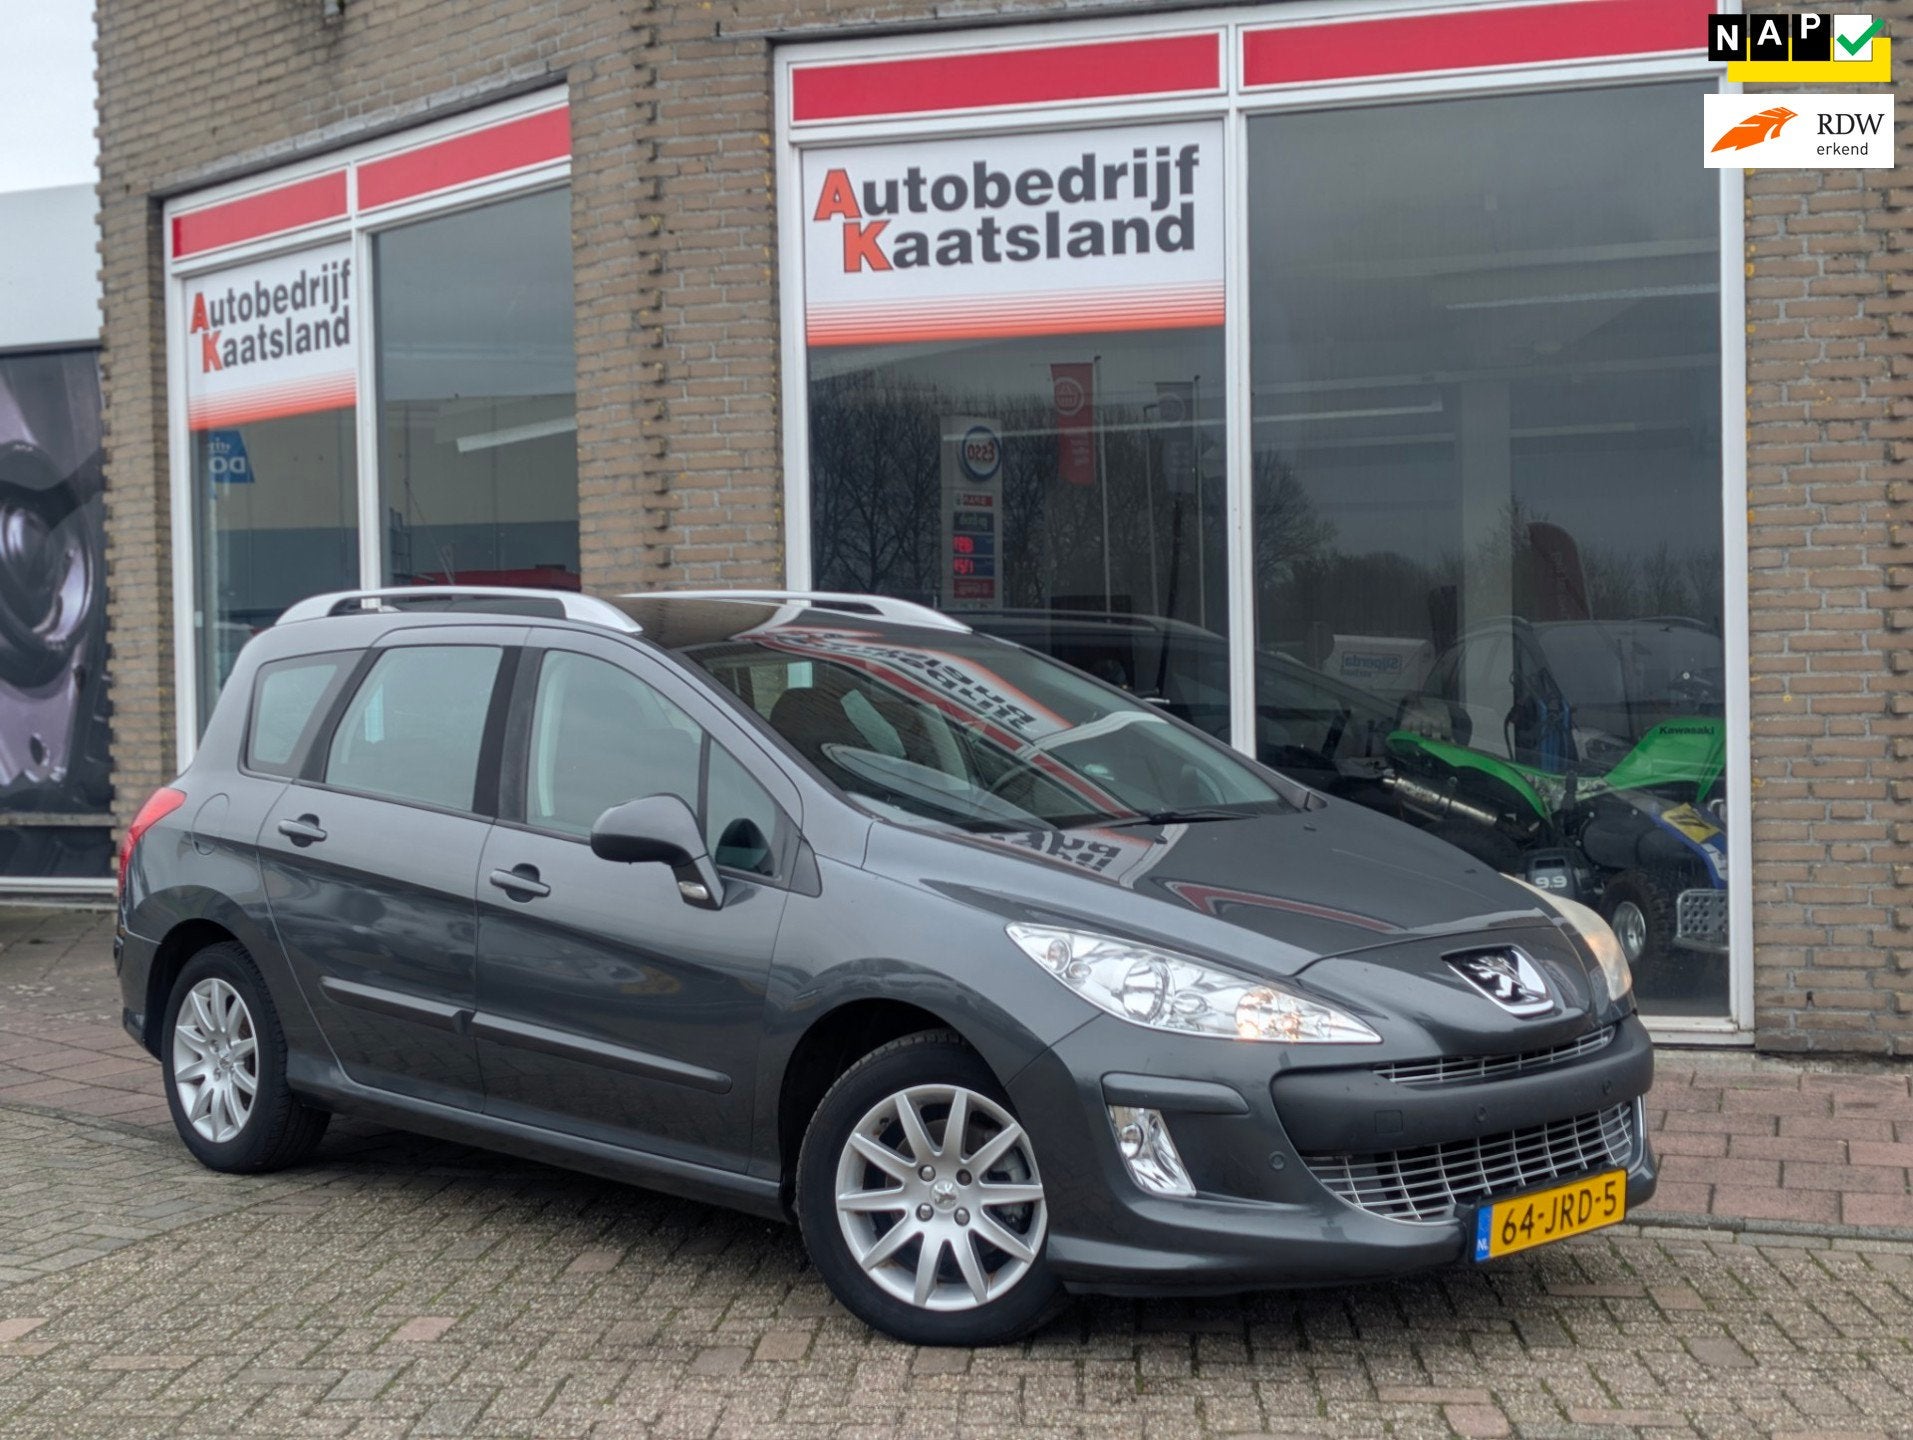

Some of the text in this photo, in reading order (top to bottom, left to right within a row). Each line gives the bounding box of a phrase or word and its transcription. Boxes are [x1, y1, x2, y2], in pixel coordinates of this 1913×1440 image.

[813, 144, 1200, 224] Autobedrijf
[843, 202, 1195, 274] Kaatsland
[190, 258, 351, 334] Autobedrijf
[202, 304, 351, 374] Kaatsland
[1659, 726, 1715, 735] Kawasaki
[1535, 875, 1568, 890] 9.9
[1501, 1180, 1617, 1246] 64-JRD-5
